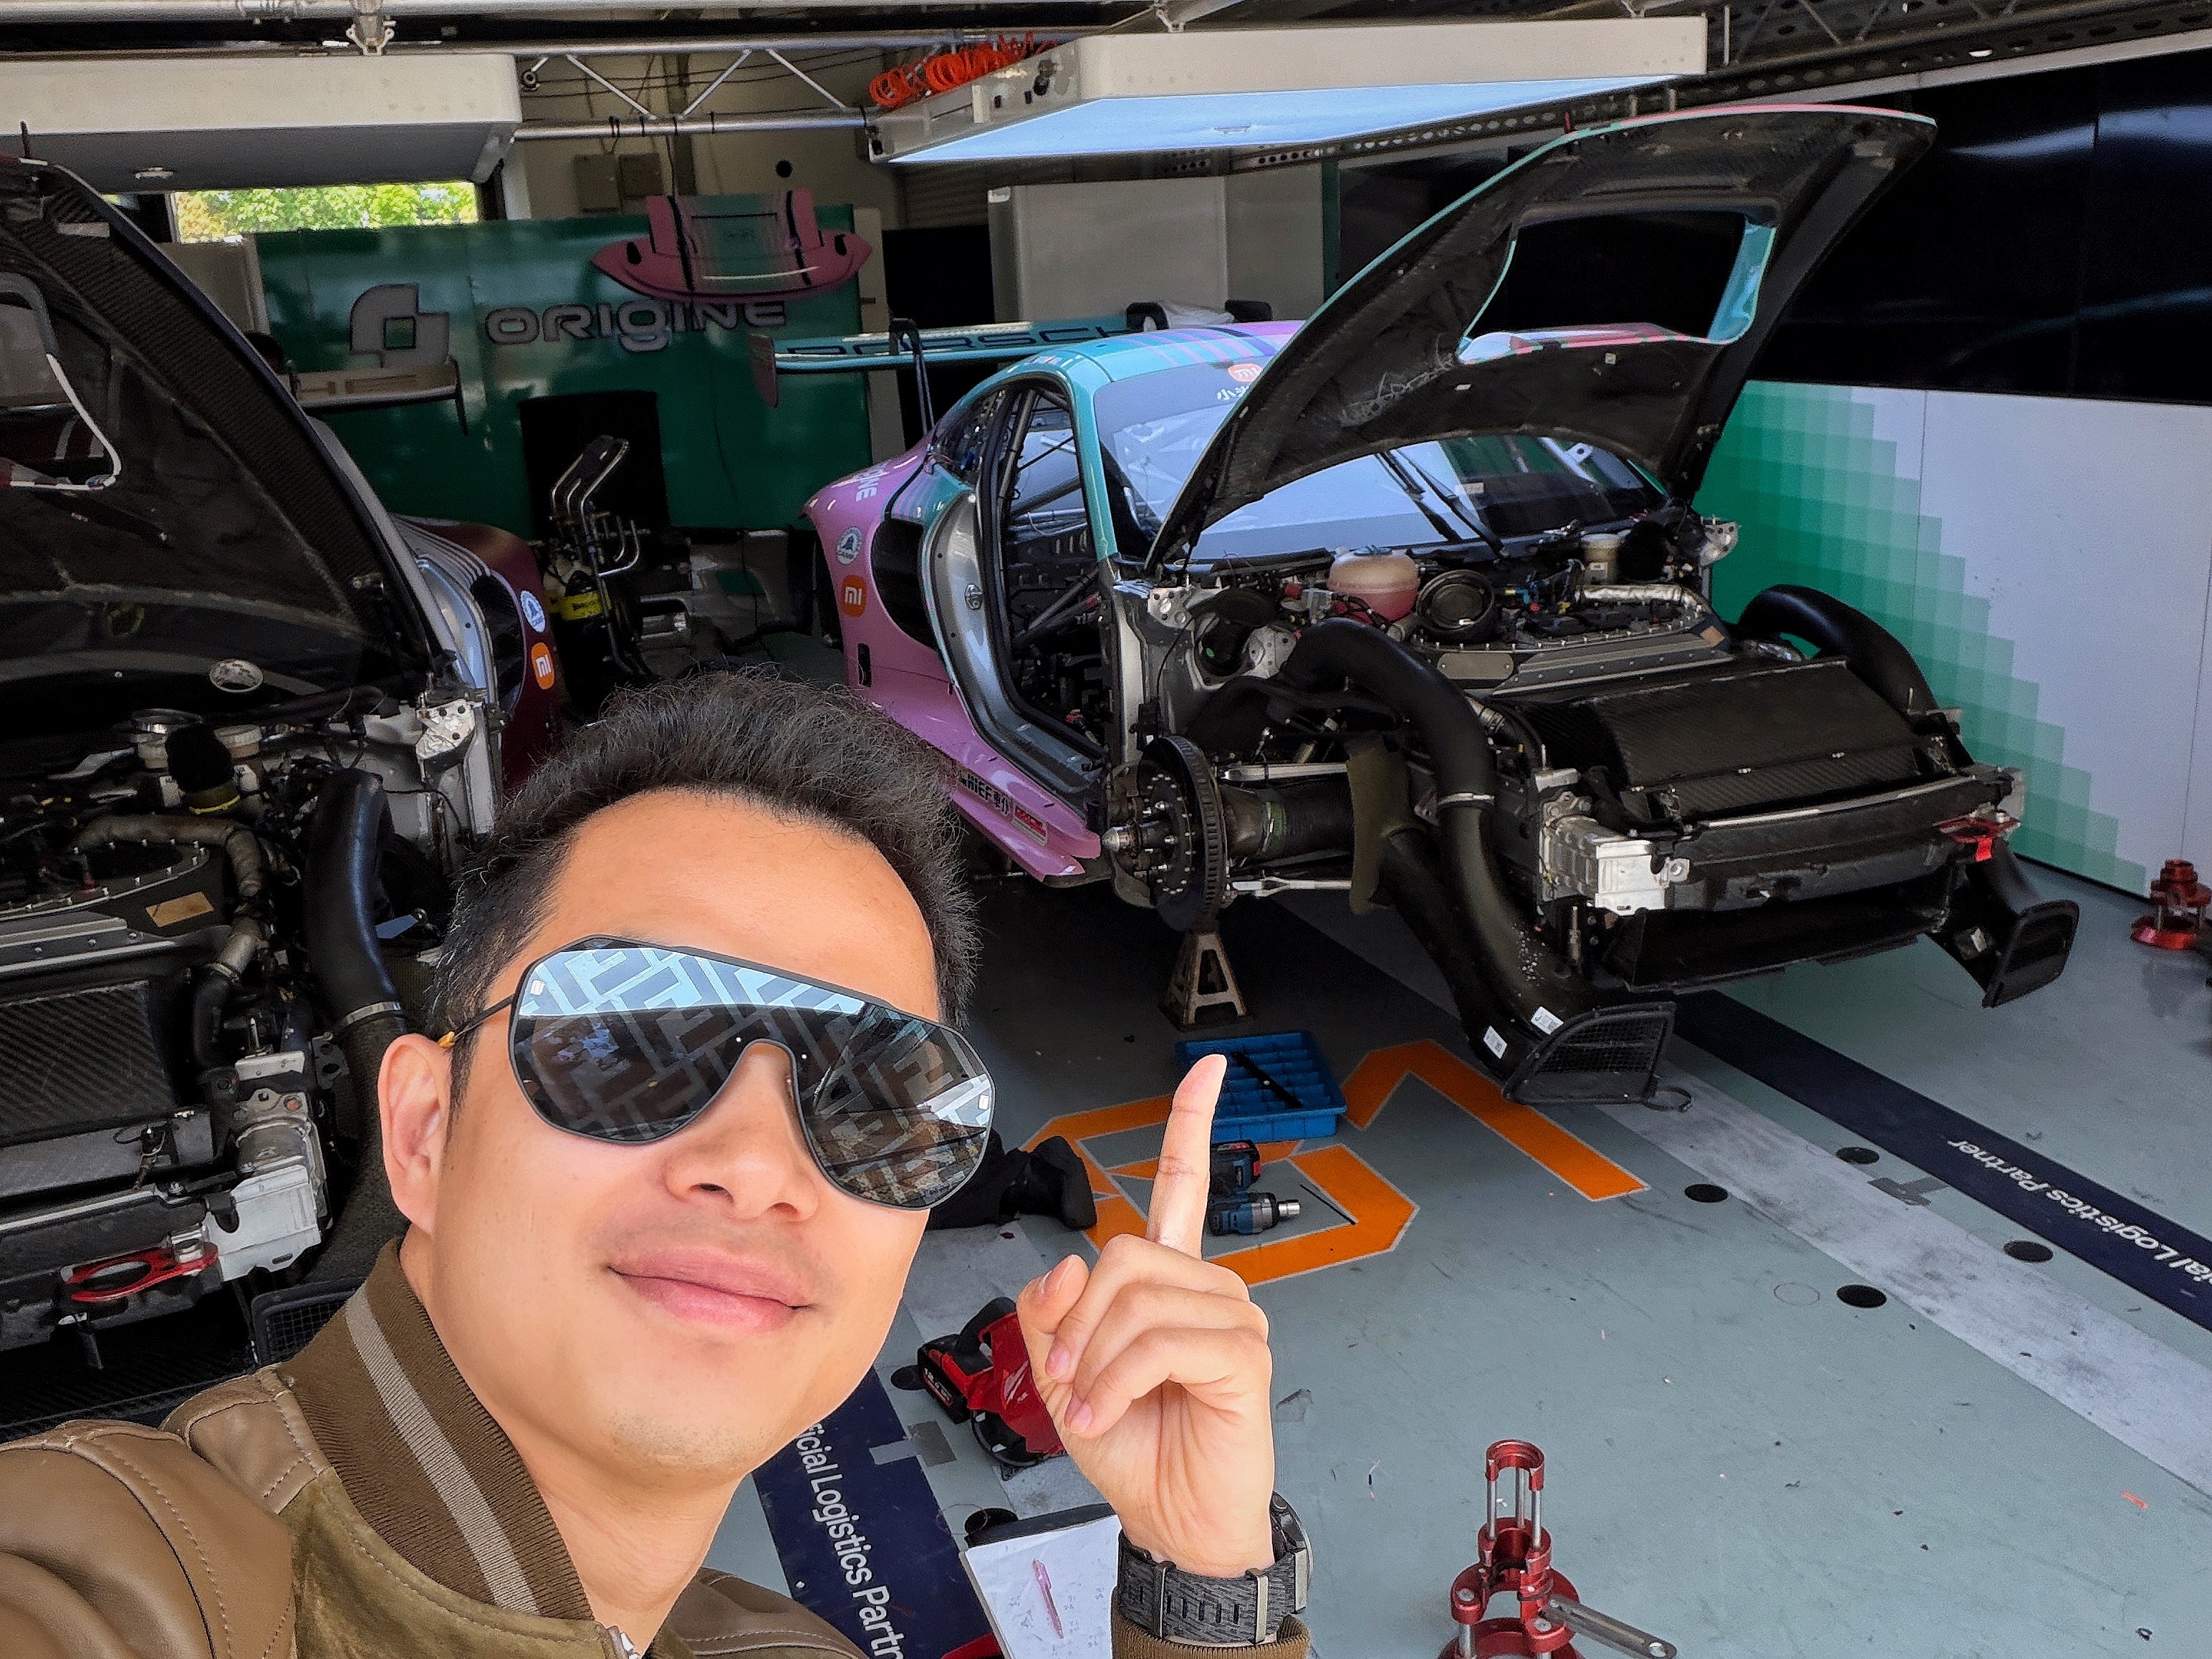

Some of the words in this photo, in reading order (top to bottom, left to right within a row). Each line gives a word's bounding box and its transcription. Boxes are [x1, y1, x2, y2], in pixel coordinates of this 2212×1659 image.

[1947, 1140, 2051, 1192] Partner
[2046, 1189, 2179, 1261] Logistics
[2168, 1258, 2212, 1284] ial
[811, 1473, 872, 1586] Logistics
